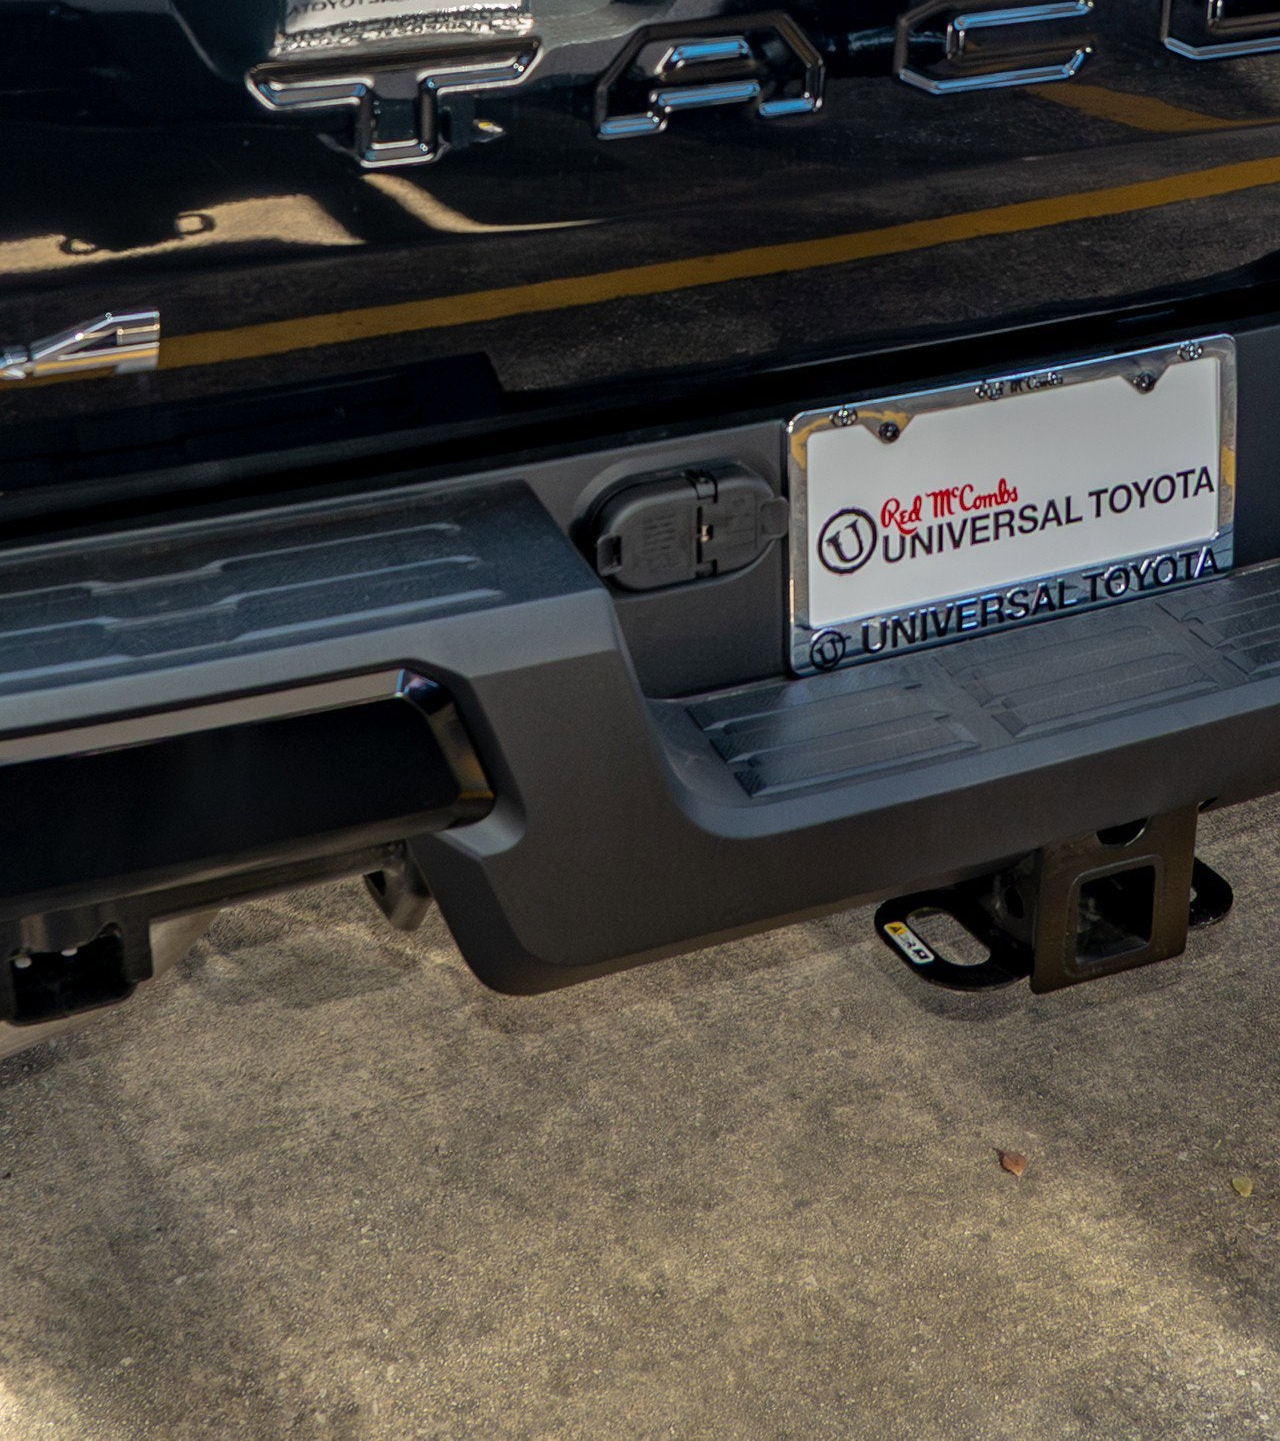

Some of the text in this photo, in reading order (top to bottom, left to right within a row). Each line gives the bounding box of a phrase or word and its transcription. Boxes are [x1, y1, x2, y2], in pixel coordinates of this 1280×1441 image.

[881, 478, 1018, 535] Red McCombs
[883, 466, 1215, 564] UNIVERSAL TOYOTA
[862, 579, 1078, 654] UNIVERSAL
[1082, 546, 1220, 602] TOYOTA
